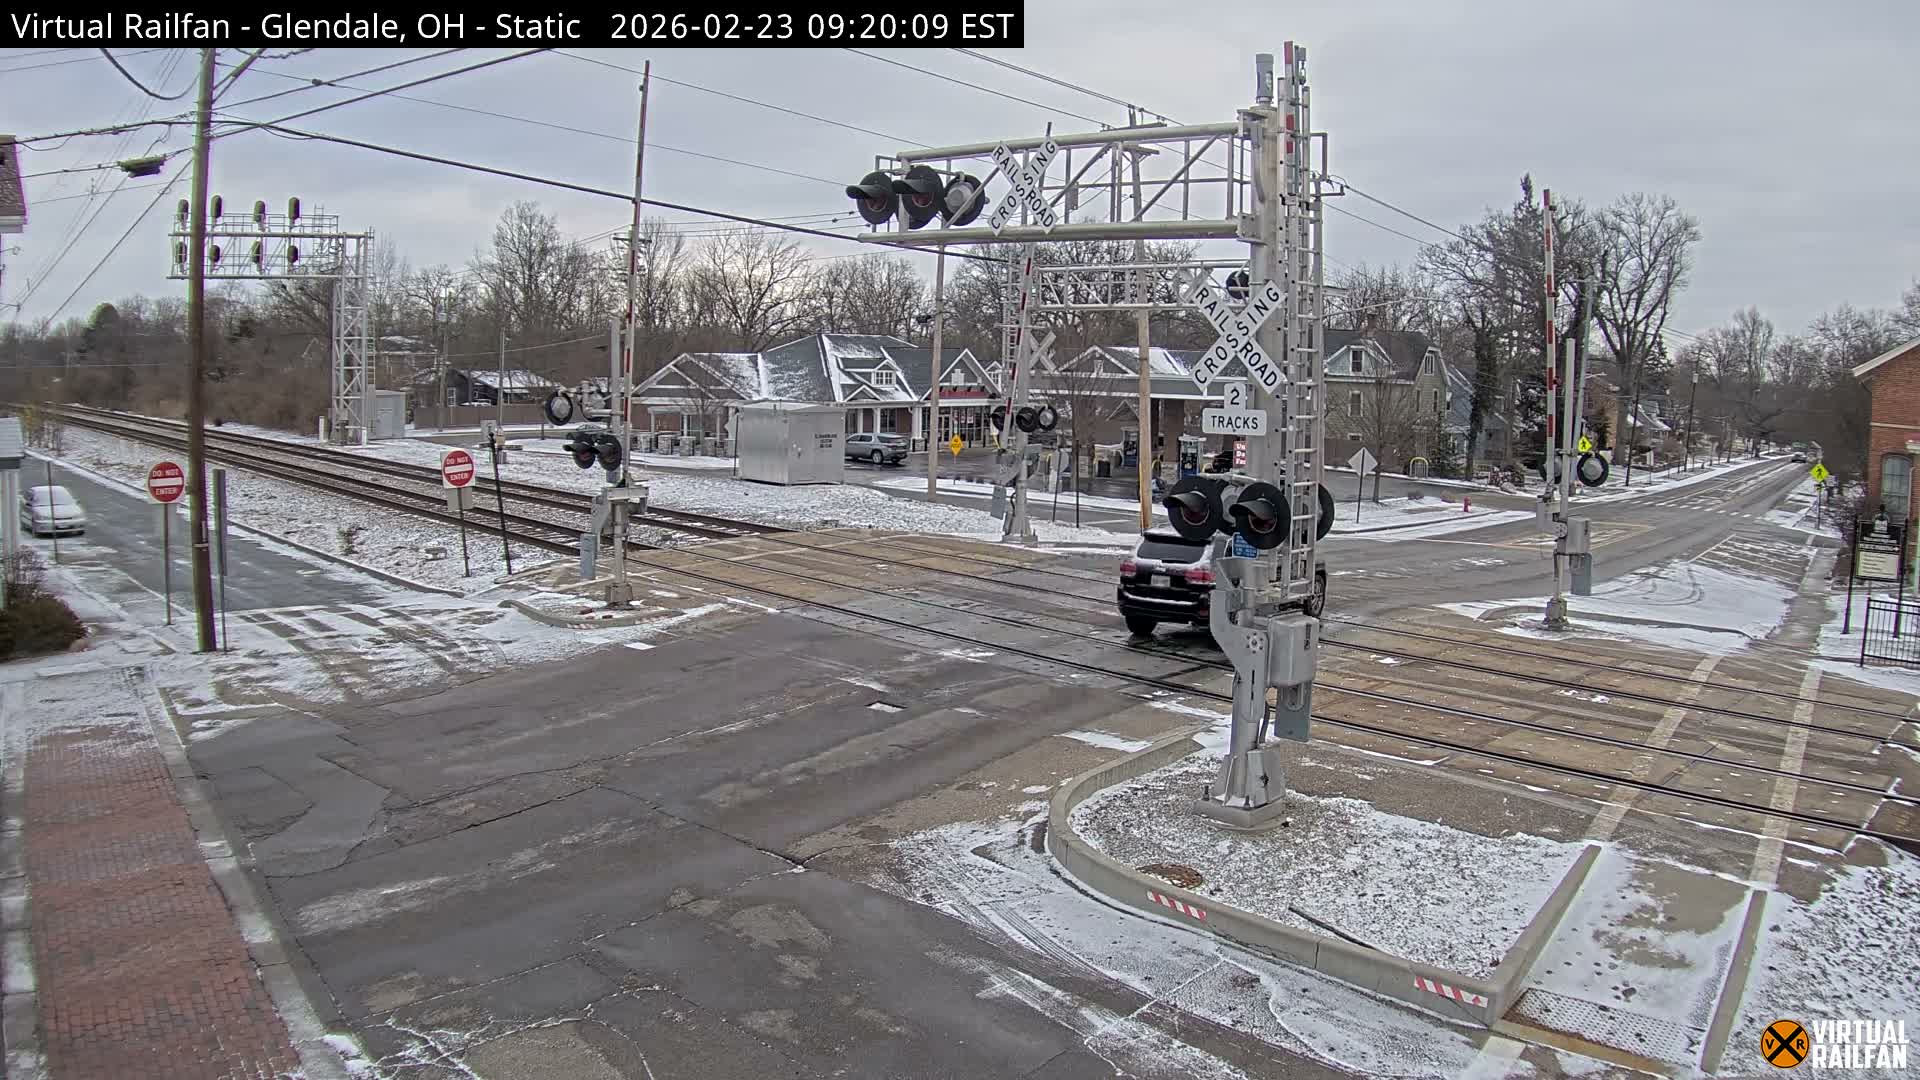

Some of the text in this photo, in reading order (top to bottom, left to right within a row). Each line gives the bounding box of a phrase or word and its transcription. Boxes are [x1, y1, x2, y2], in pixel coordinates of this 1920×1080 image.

[991, 142, 1055, 230] CROSSING
[994, 146, 1054, 228] RAILROAD
[1194, 287, 1280, 384] CROSSING
[1195, 287, 1278, 387] RAILROAD
[1230, 388, 1240, 406] 2
[1211, 415, 1259, 430] TRACKS
[446, 457, 455, 465] DO
[450, 472, 469, 480] ENTER
